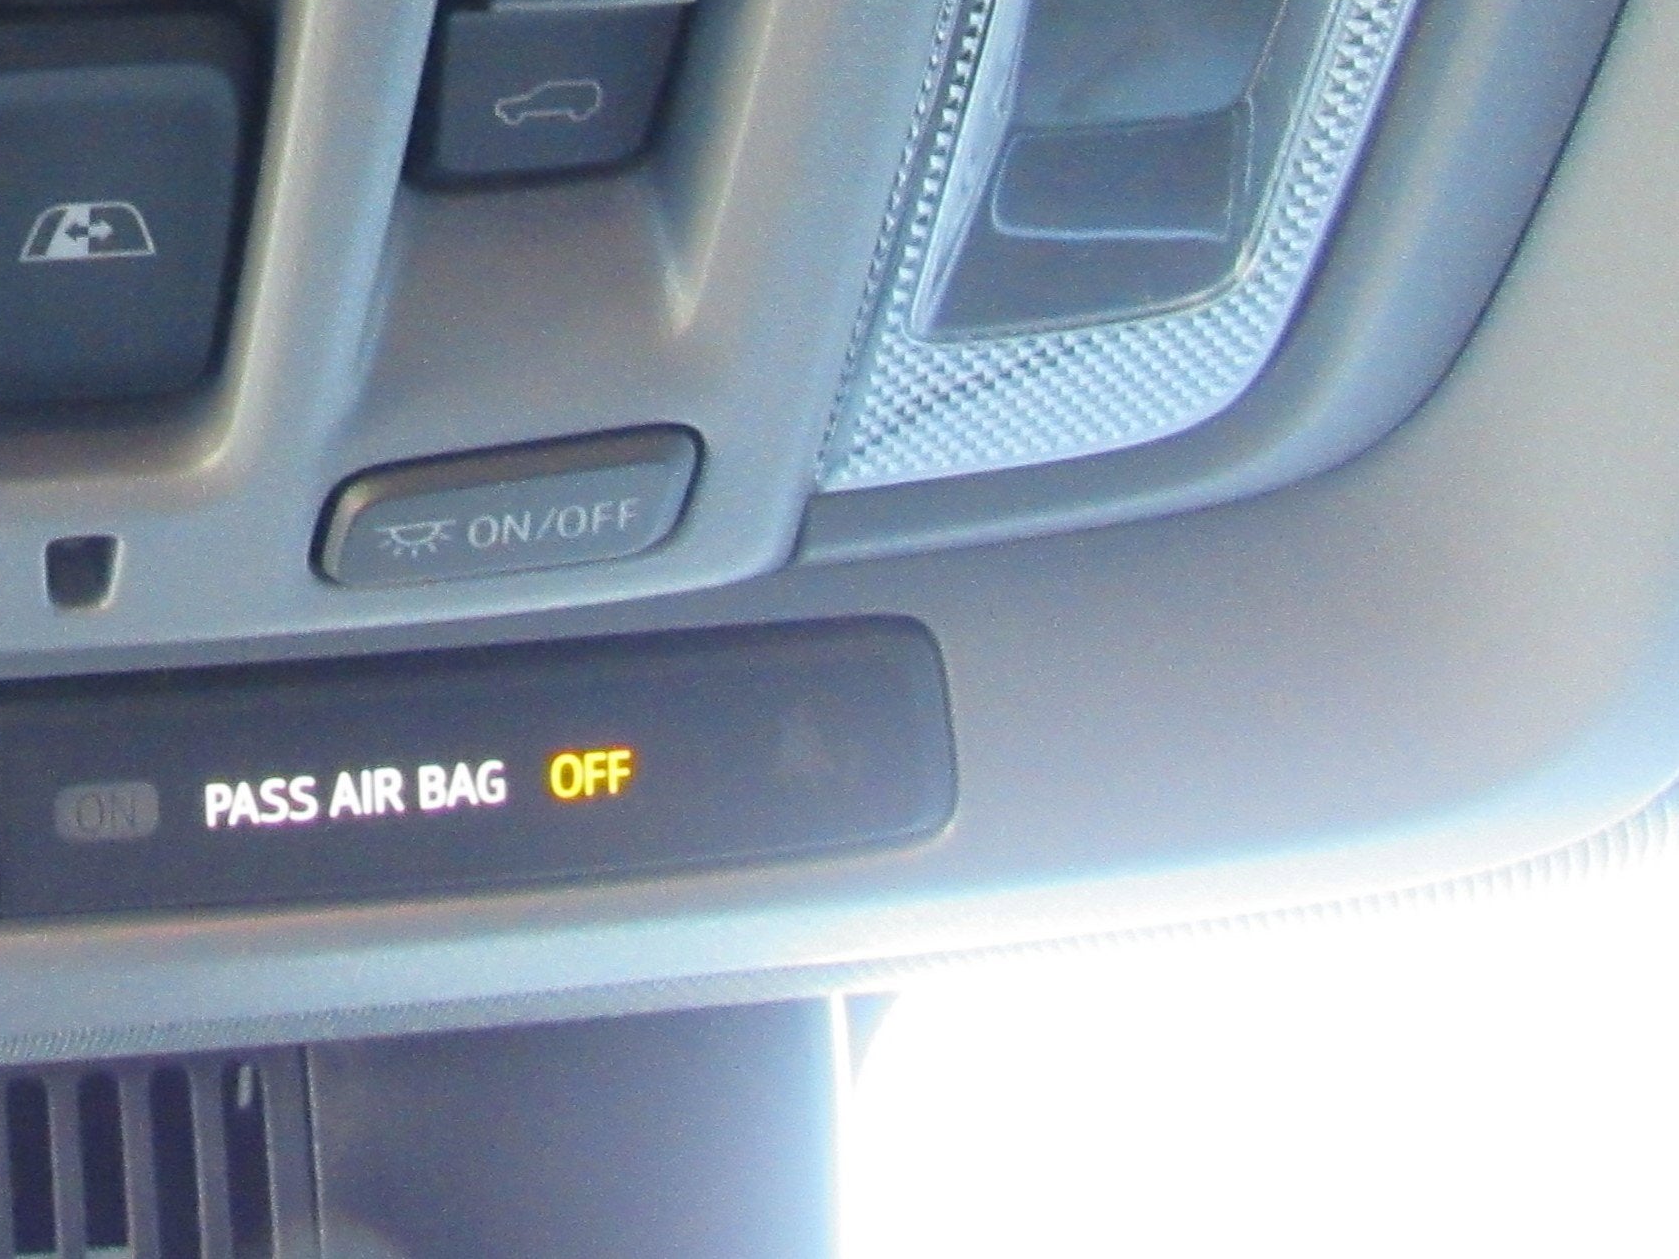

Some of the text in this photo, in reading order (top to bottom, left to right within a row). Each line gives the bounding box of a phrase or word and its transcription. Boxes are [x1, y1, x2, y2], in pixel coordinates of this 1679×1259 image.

[467, 498, 640, 548] ON/OFF
[204, 776, 318, 828] PASS
[329, 768, 404, 818] AIR
[417, 760, 507, 811] BAG
[549, 749, 633, 800] OFF
